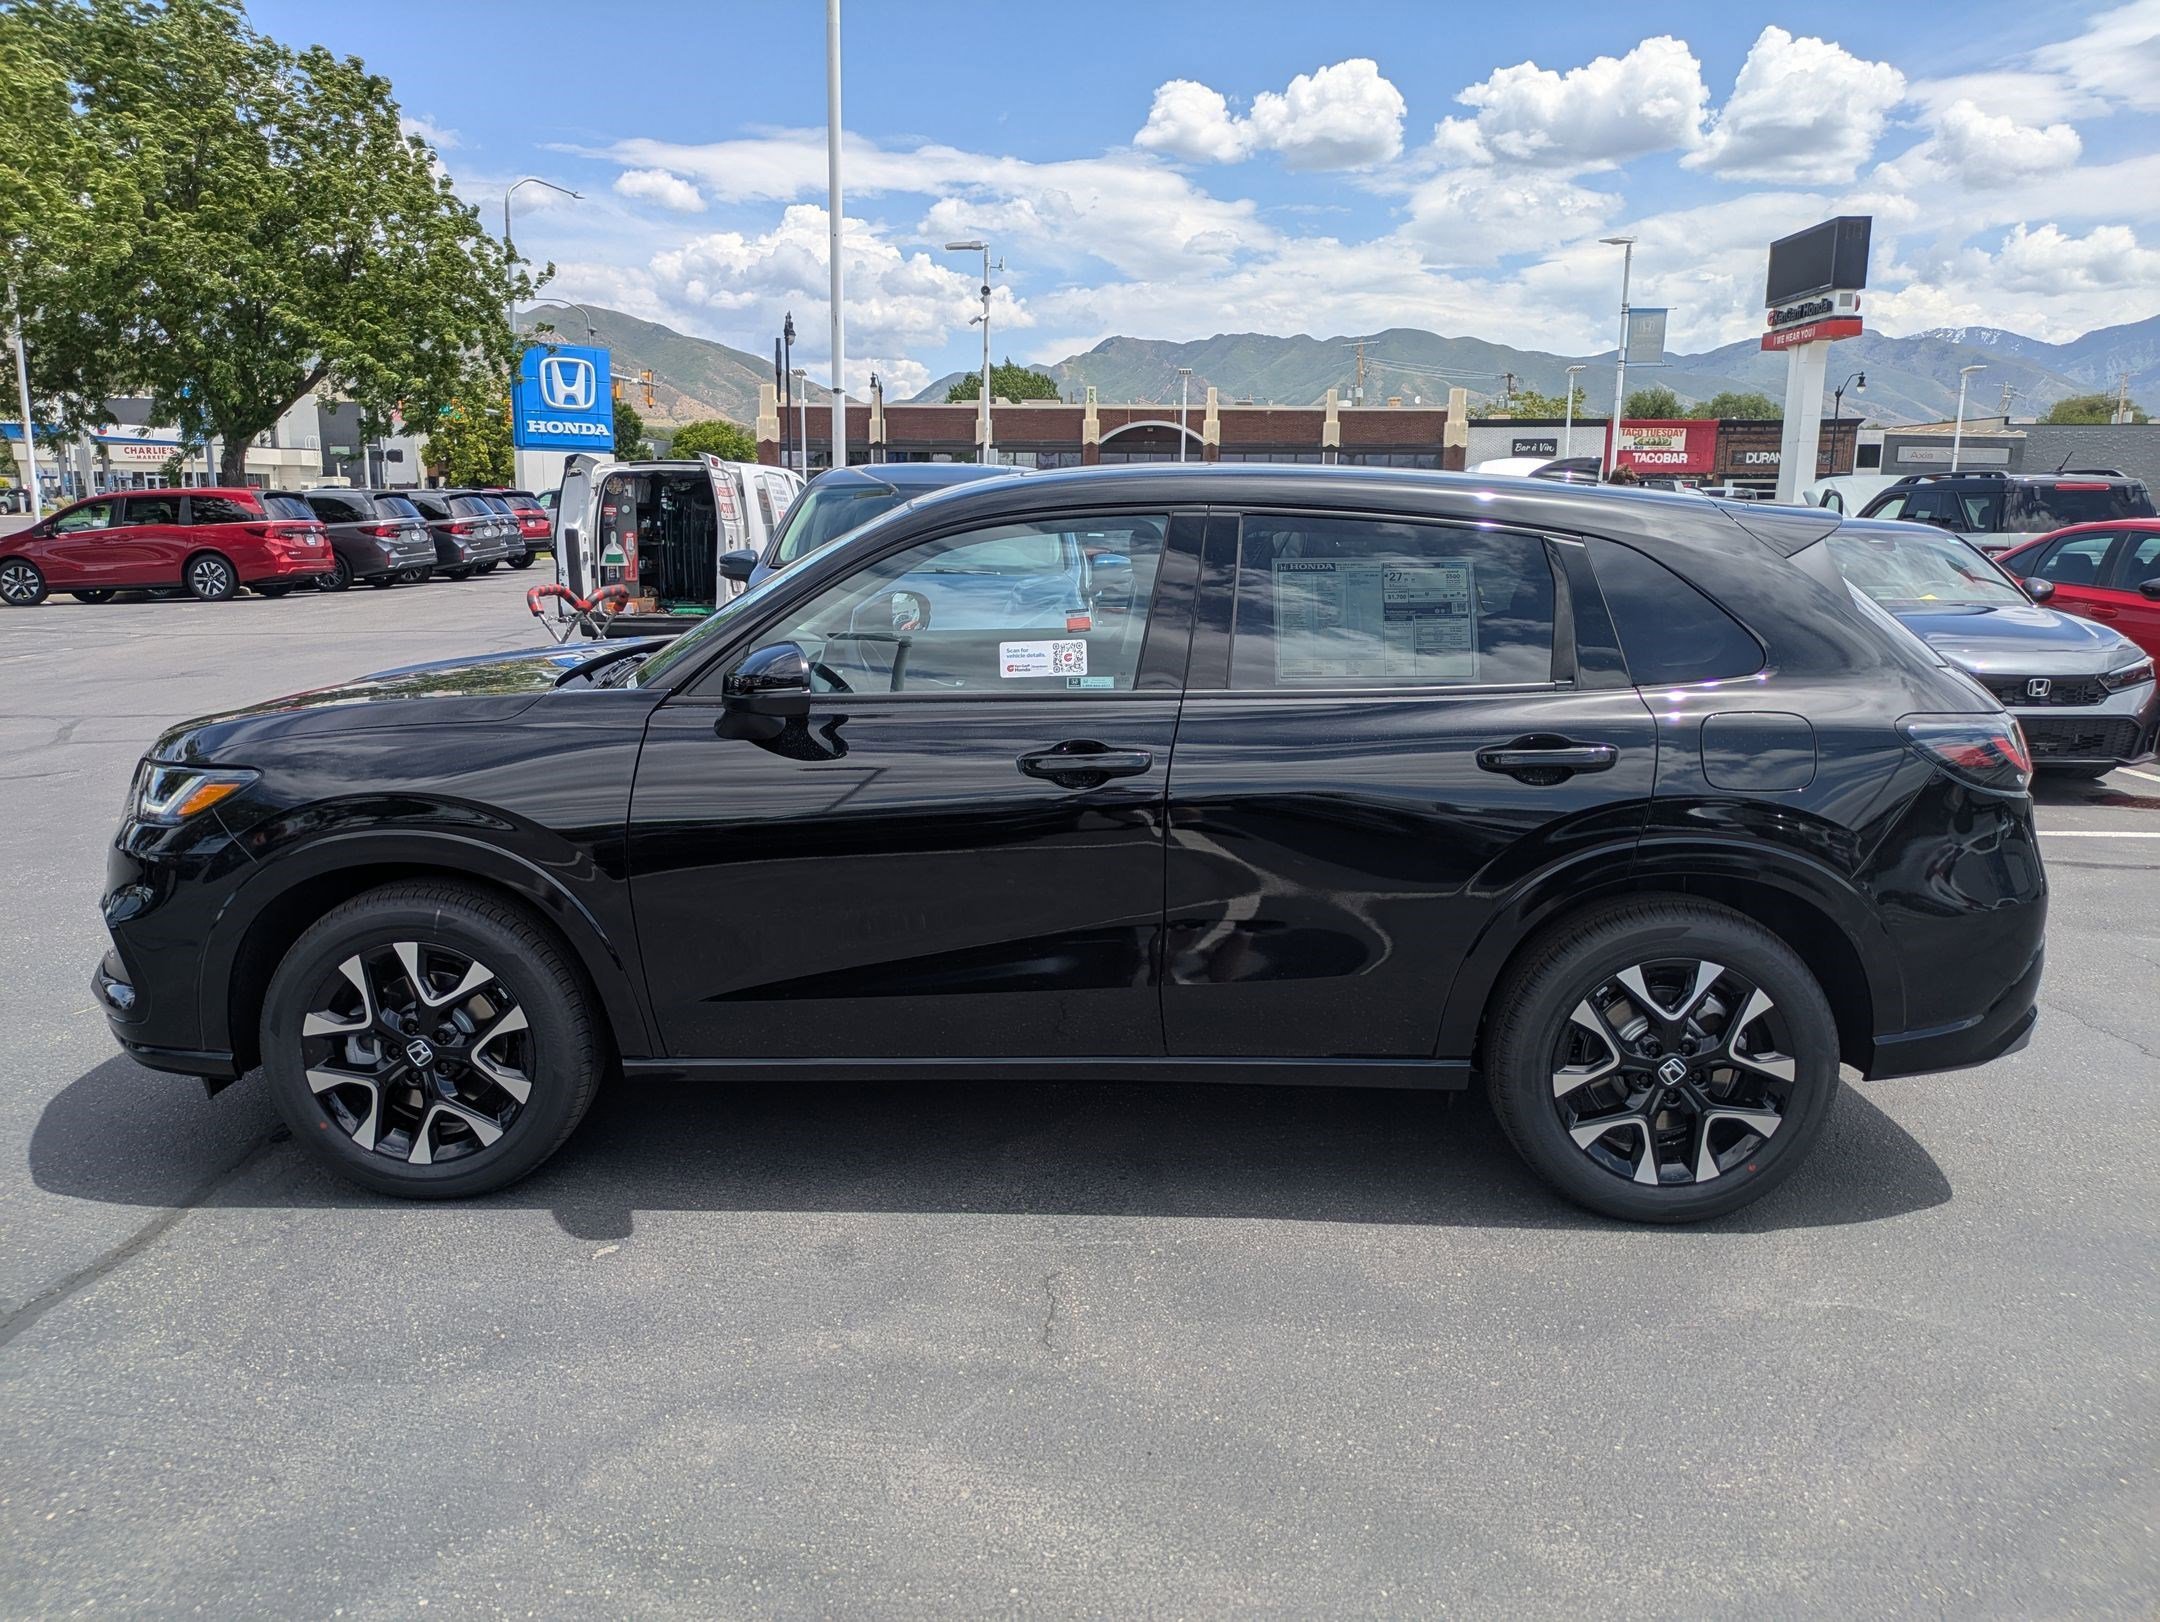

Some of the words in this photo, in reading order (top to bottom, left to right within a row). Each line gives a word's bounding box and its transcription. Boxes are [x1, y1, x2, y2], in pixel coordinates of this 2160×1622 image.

[1776, 334, 1785, 344] WE
[1786, 331, 1800, 343] HEAR
[526, 420, 610, 436] HONDA
[1622, 429, 1643, 437] TACO
[1646, 429, 1684, 437] TUESDAY
[123, 446, 175, 455] CHARLIE'S
[1514, 443, 1530, 452] Bar
[1539, 443, 1555, 452] Vin
[1633, 453, 1688, 464] TACOBAR
[1389, 572, 1402, 581] 27
